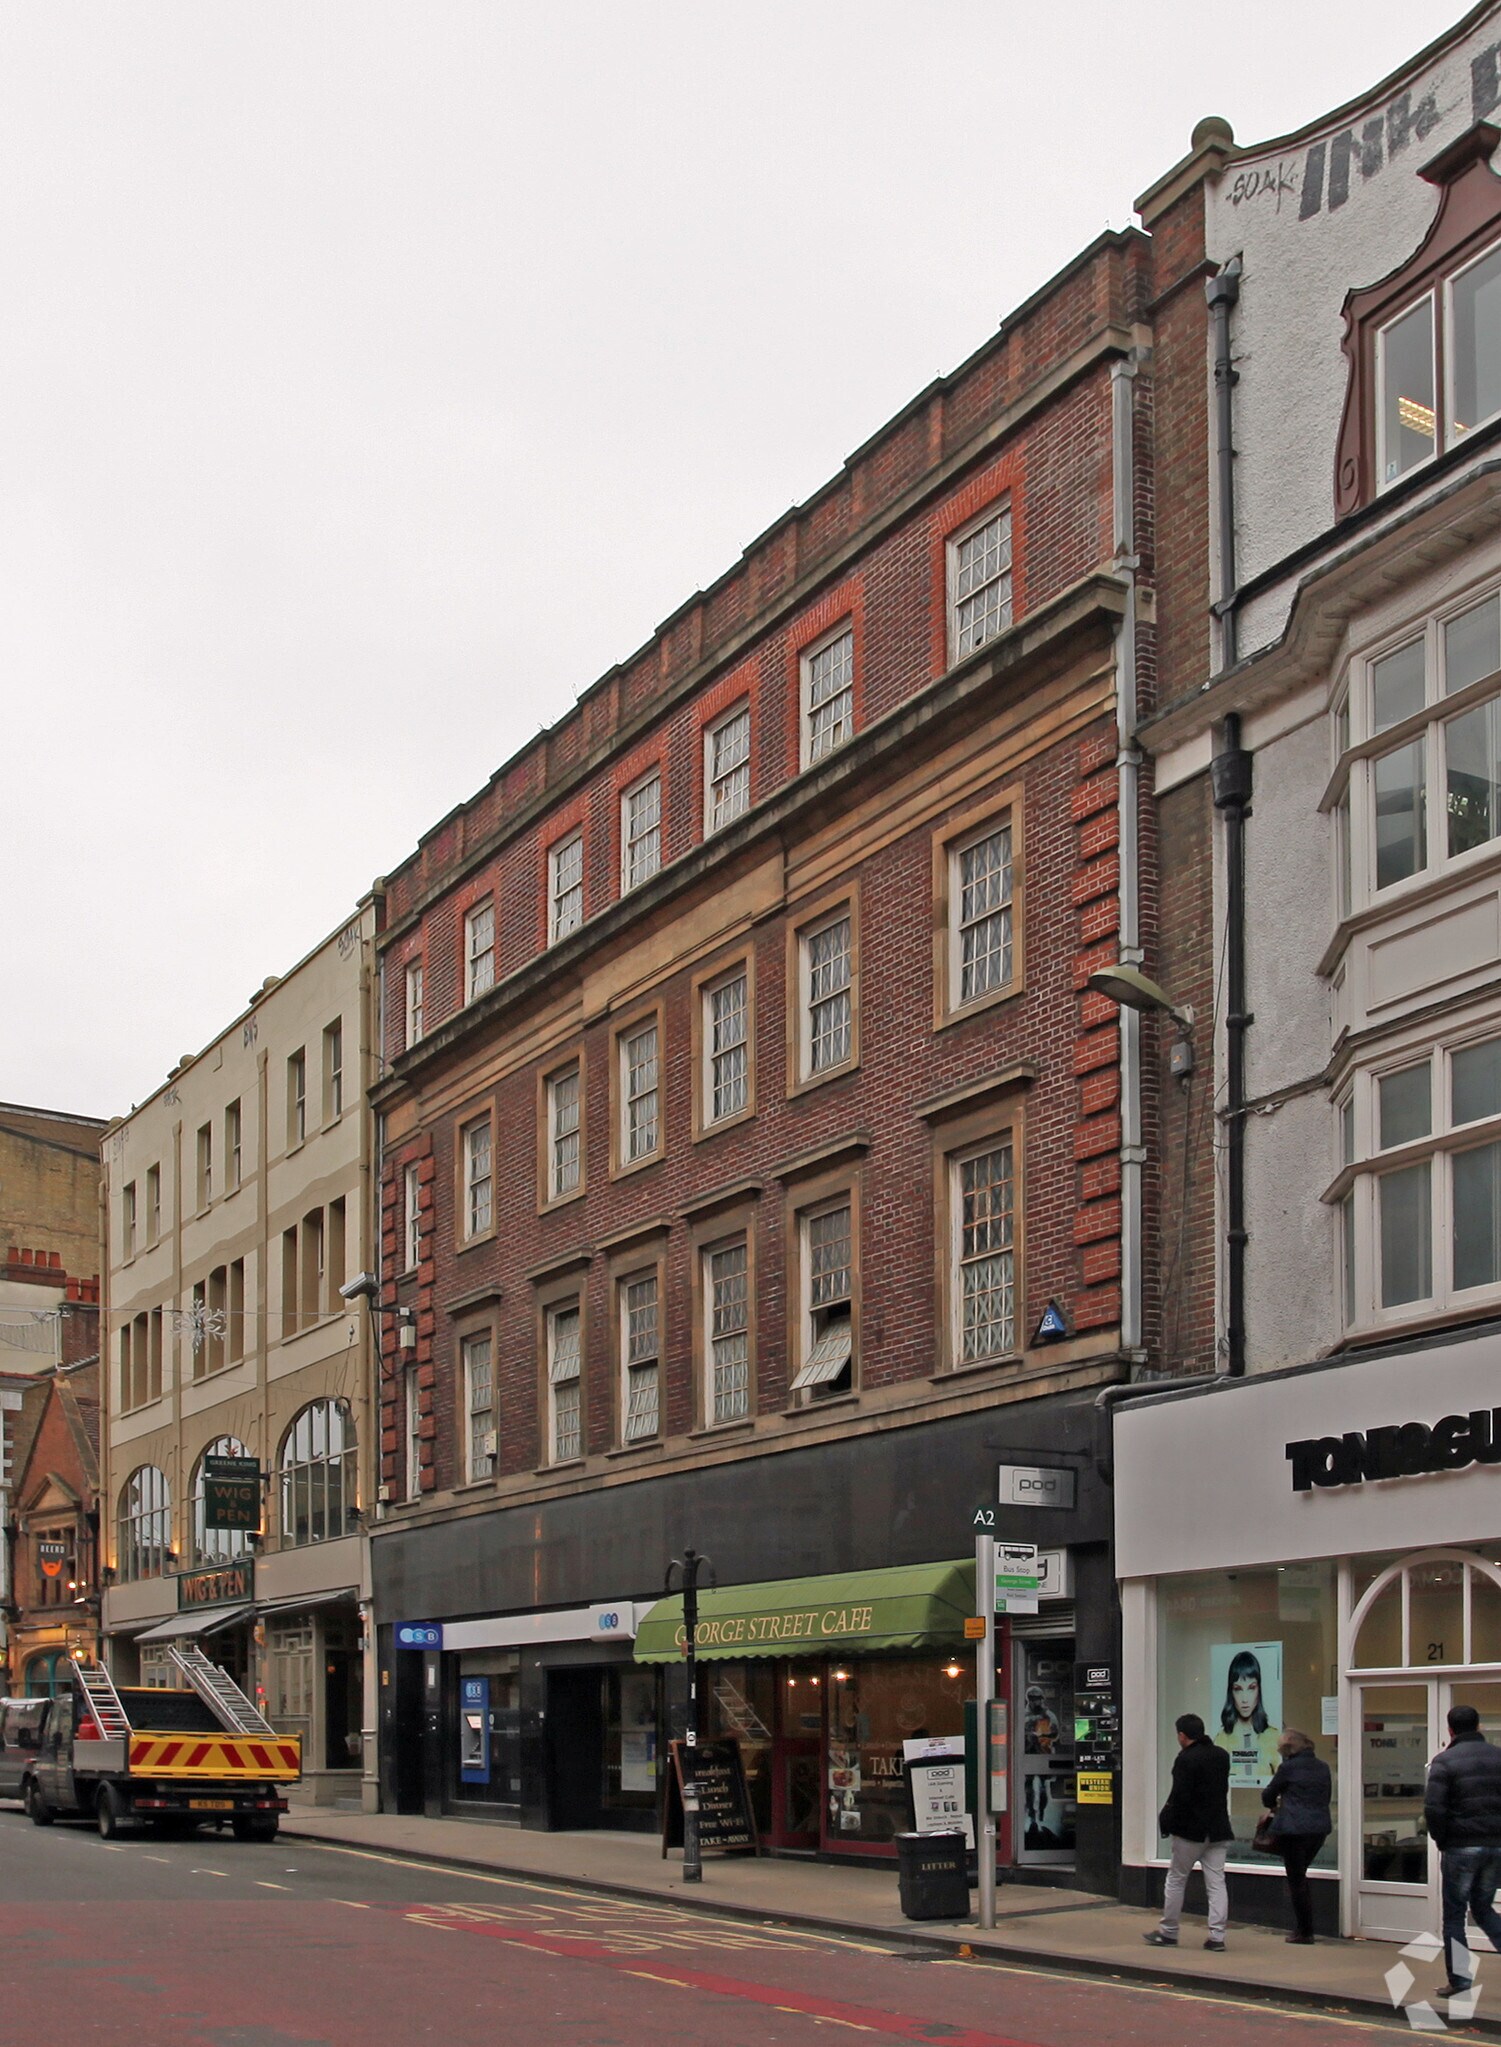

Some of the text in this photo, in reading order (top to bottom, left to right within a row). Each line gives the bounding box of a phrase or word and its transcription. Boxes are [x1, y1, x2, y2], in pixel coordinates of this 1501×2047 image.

[1019, 1479, 1057, 1491] pod
[214, 1487, 251, 1500] WIG
[216, 1510, 250, 1522] PEN
[973, 1510, 995, 1526] A2
[1003, 1565, 1031, 1575] Bus Stop
[183, 1568, 245, 1601] WIG & PEN
[674, 1607, 873, 1646] GORGE STREET CAFE
[1428, 1642, 1443, 1660] 21
[695, 1765, 731, 1778] reakfast
[931, 1769, 950, 1777] pod
[701, 1781, 729, 1794] Lunch
[702, 1802, 733, 1811] Dinner
[700, 1821, 717, 1829] Free
[922, 1861, 956, 1870] LITTER
[404, 1902, 689, 1922] STOP
[534, 1929, 818, 1954] BUS
